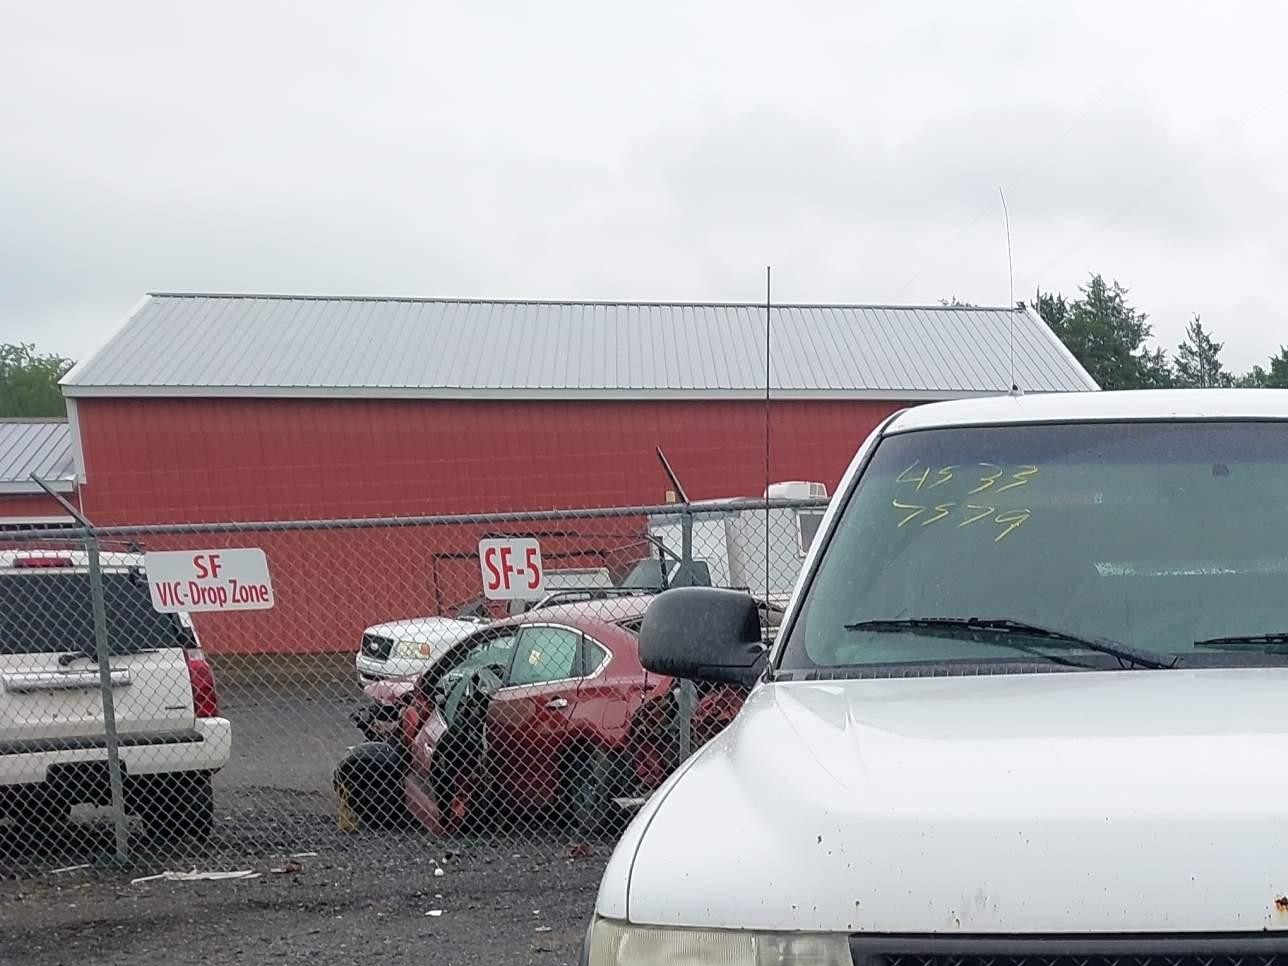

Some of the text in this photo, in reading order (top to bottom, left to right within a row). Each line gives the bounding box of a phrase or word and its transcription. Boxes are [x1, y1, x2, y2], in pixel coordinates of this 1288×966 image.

[193, 554, 221, 579] SF
[484, 546, 540, 591] SF-5
[156, 578, 269, 609] VIC-Drop Zone
